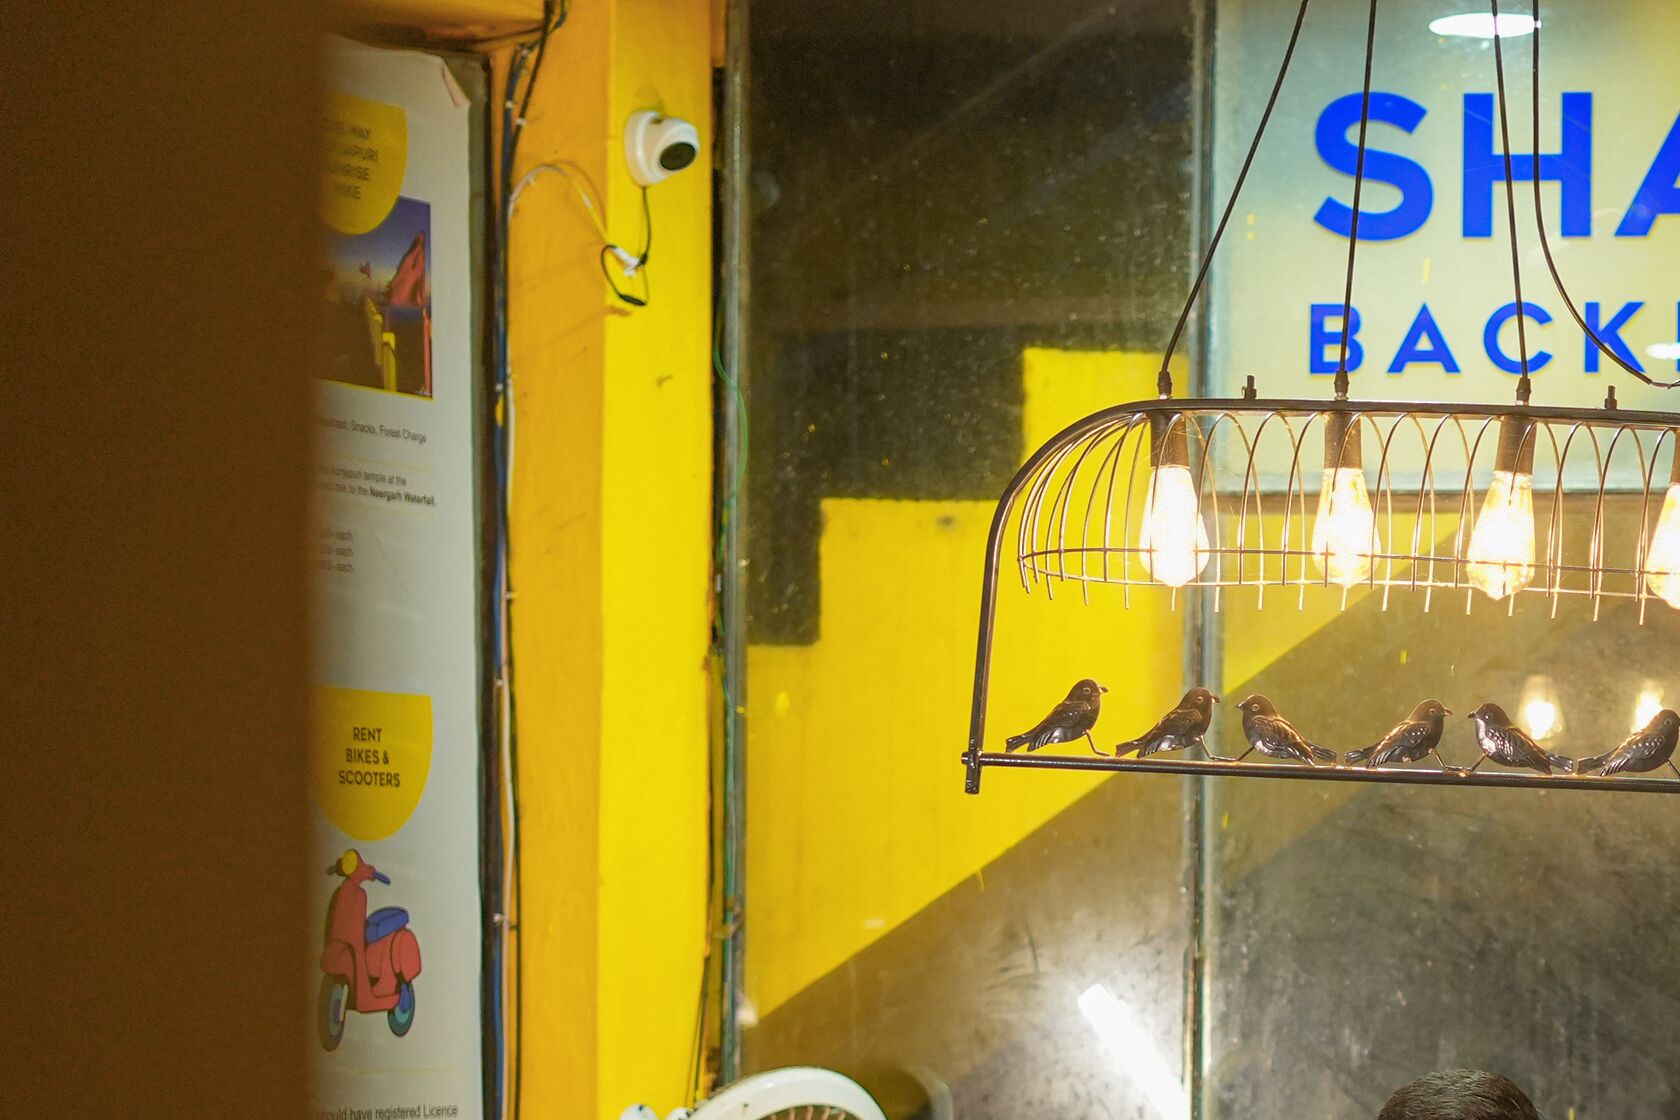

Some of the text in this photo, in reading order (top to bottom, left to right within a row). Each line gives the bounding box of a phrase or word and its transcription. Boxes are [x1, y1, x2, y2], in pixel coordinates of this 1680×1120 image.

[353, 727, 382, 742] RENT
[345, 748, 389, 765] BIKES &
[338, 770, 400, 788] SCOOTERS
